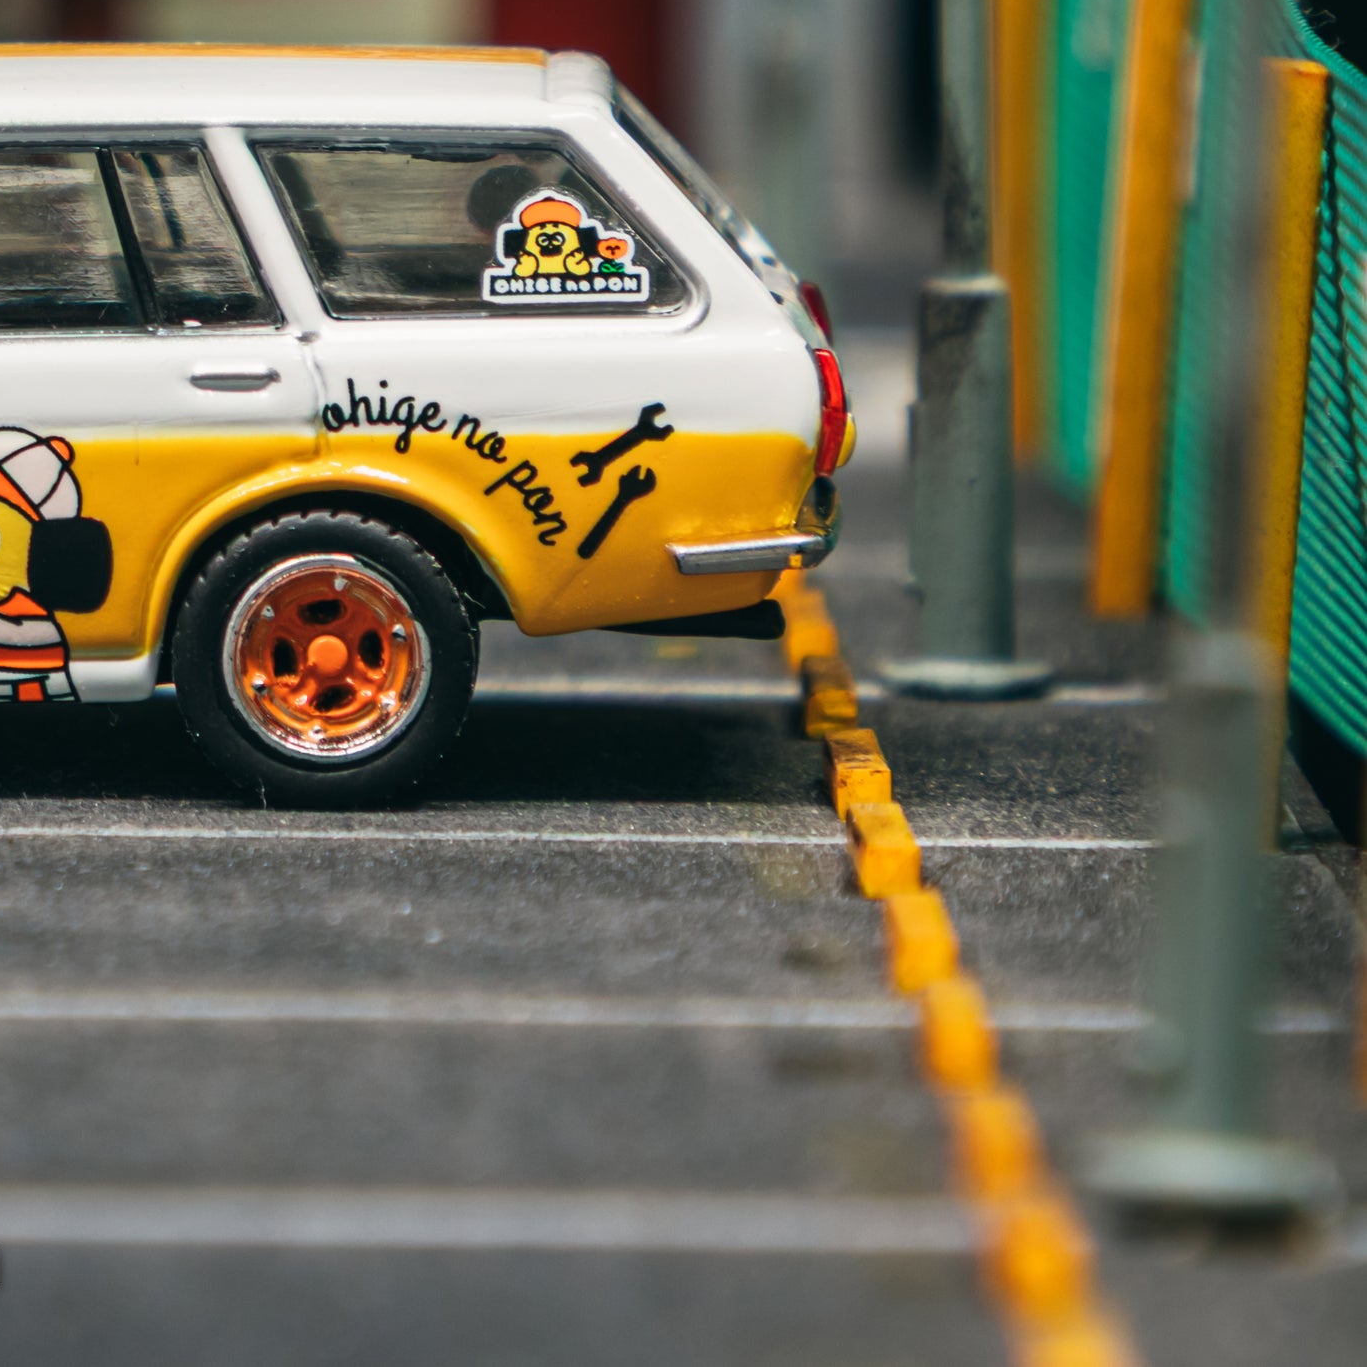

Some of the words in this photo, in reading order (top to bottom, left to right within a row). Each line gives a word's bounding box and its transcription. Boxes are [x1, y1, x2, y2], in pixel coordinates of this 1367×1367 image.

[493, 277, 563, 294] OHIGE
[592, 276, 639, 292] PON
[321, 376, 448, 455] ohige
[450, 412, 508, 465] no
[483, 459, 568, 547] pon
